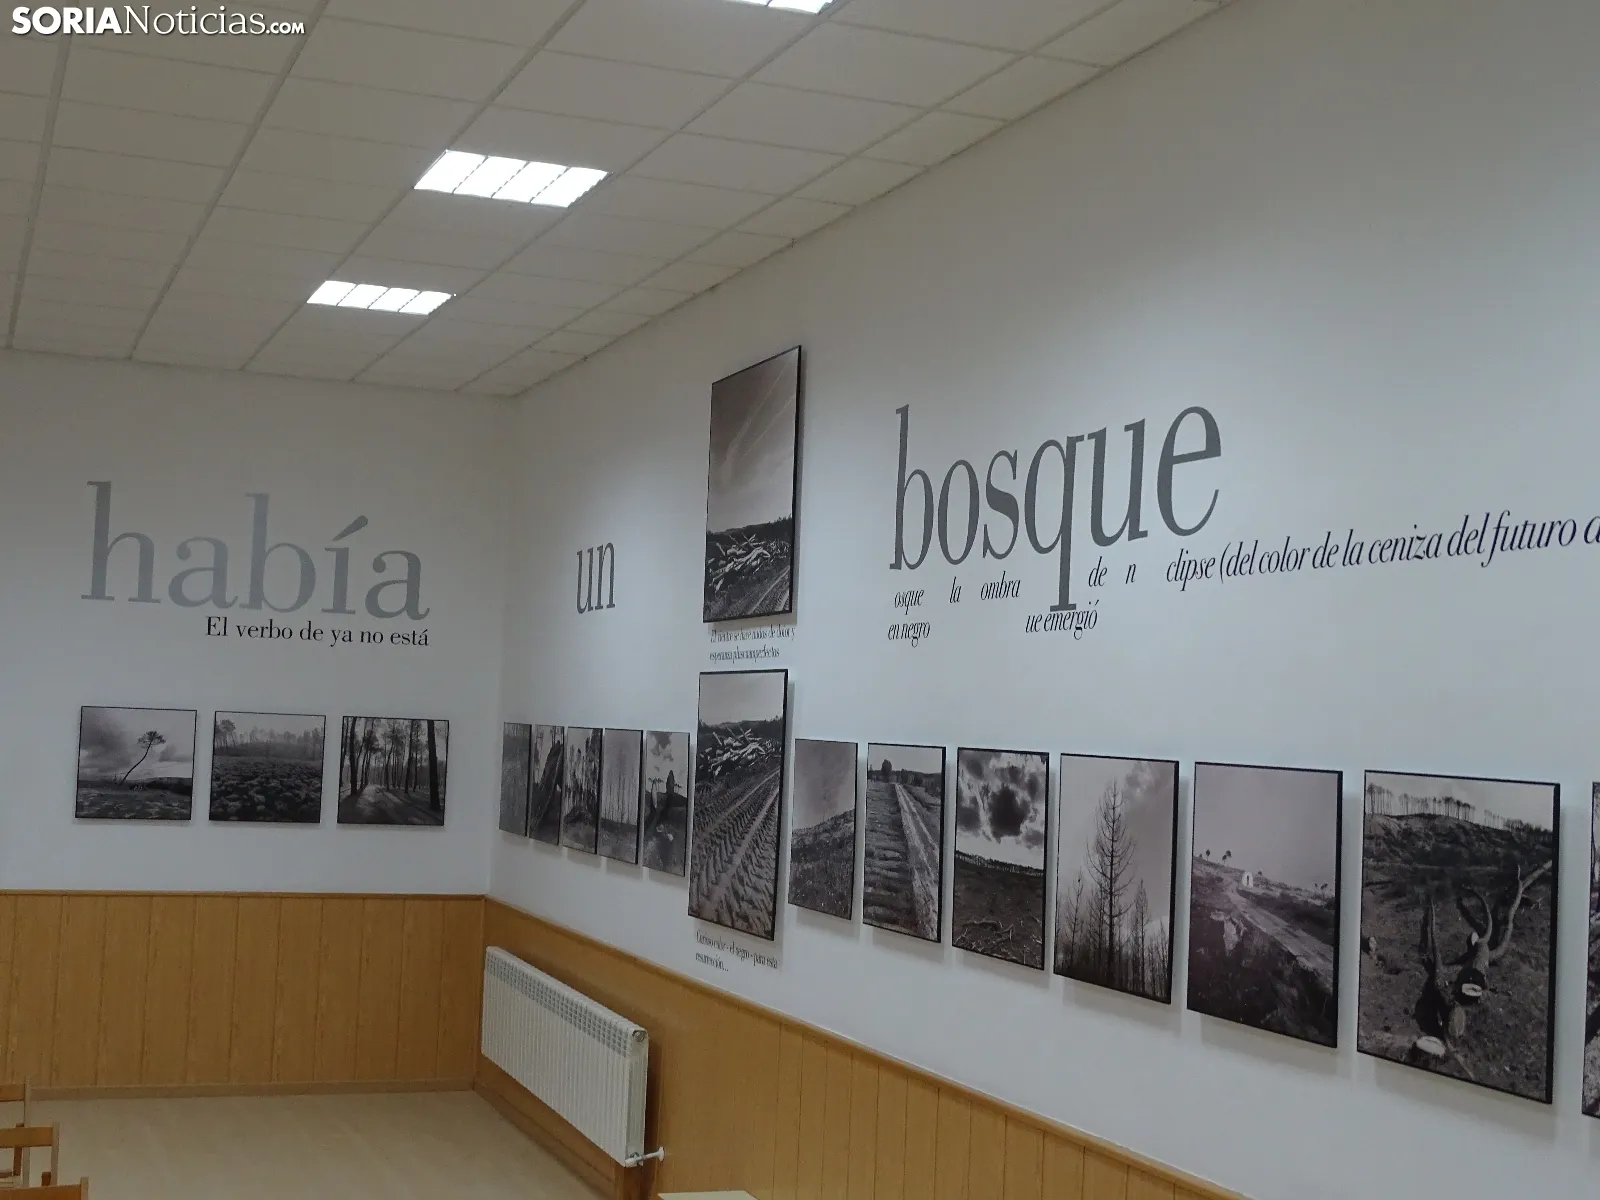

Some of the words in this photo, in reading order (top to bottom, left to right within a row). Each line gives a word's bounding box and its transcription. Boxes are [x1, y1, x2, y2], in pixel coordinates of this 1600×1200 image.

[81, 480, 431, 621] había
[889, 403, 1222, 613] bosque
[576, 541, 616, 615] un
[893, 588, 925, 615] osque
[949, 576, 962, 604] la
[980, 571, 1021, 601] ombra
[1088, 556, 1108, 588] de
[1125, 562, 1137, 585] n
[1166, 548, 1217, 592] clipse
[1220, 541, 1257, 584] (del
[1257, 535, 1311, 574] color
[1310, 531, 1339, 569] de
[1342, 528, 1364, 567] la
[1368, 523, 1444, 565] ceniza
[1447, 512, 1491, 558] del
[1481, 509, 1578, 569] futuro
[205, 615, 229, 637] El
[236, 619, 294, 640] verbo
[300, 621, 324, 642] de
[330, 628, 354, 648] ya
[359, 631, 384, 645] no
[390, 628, 430, 648] está
[887, 623, 901, 642] en
[900, 621, 931, 648] negro
[1025, 613, 1042, 634] ue
[1043, 600, 1099, 641] emergió
